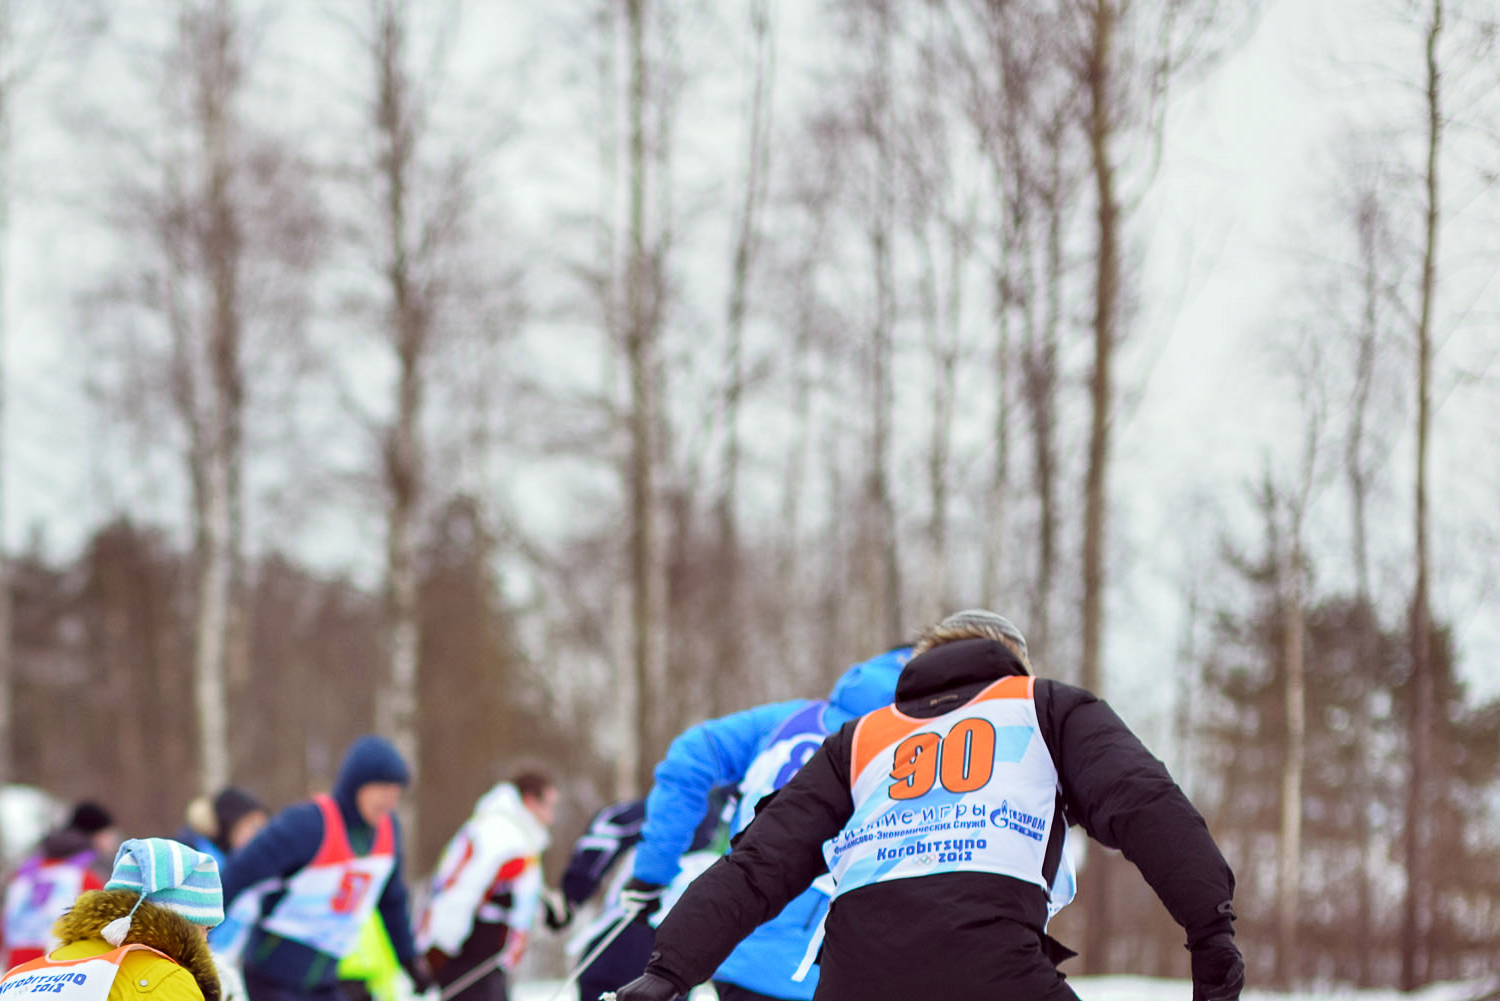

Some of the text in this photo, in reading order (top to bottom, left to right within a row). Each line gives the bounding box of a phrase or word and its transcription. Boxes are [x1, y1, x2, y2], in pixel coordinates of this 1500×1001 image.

[888, 717, 996, 801] 90
[922, 804, 986, 821] игры
[953, 819, 986, 830] Служб
[938, 851, 973, 863] 2013
[30, 982, 65, 993] 2013
